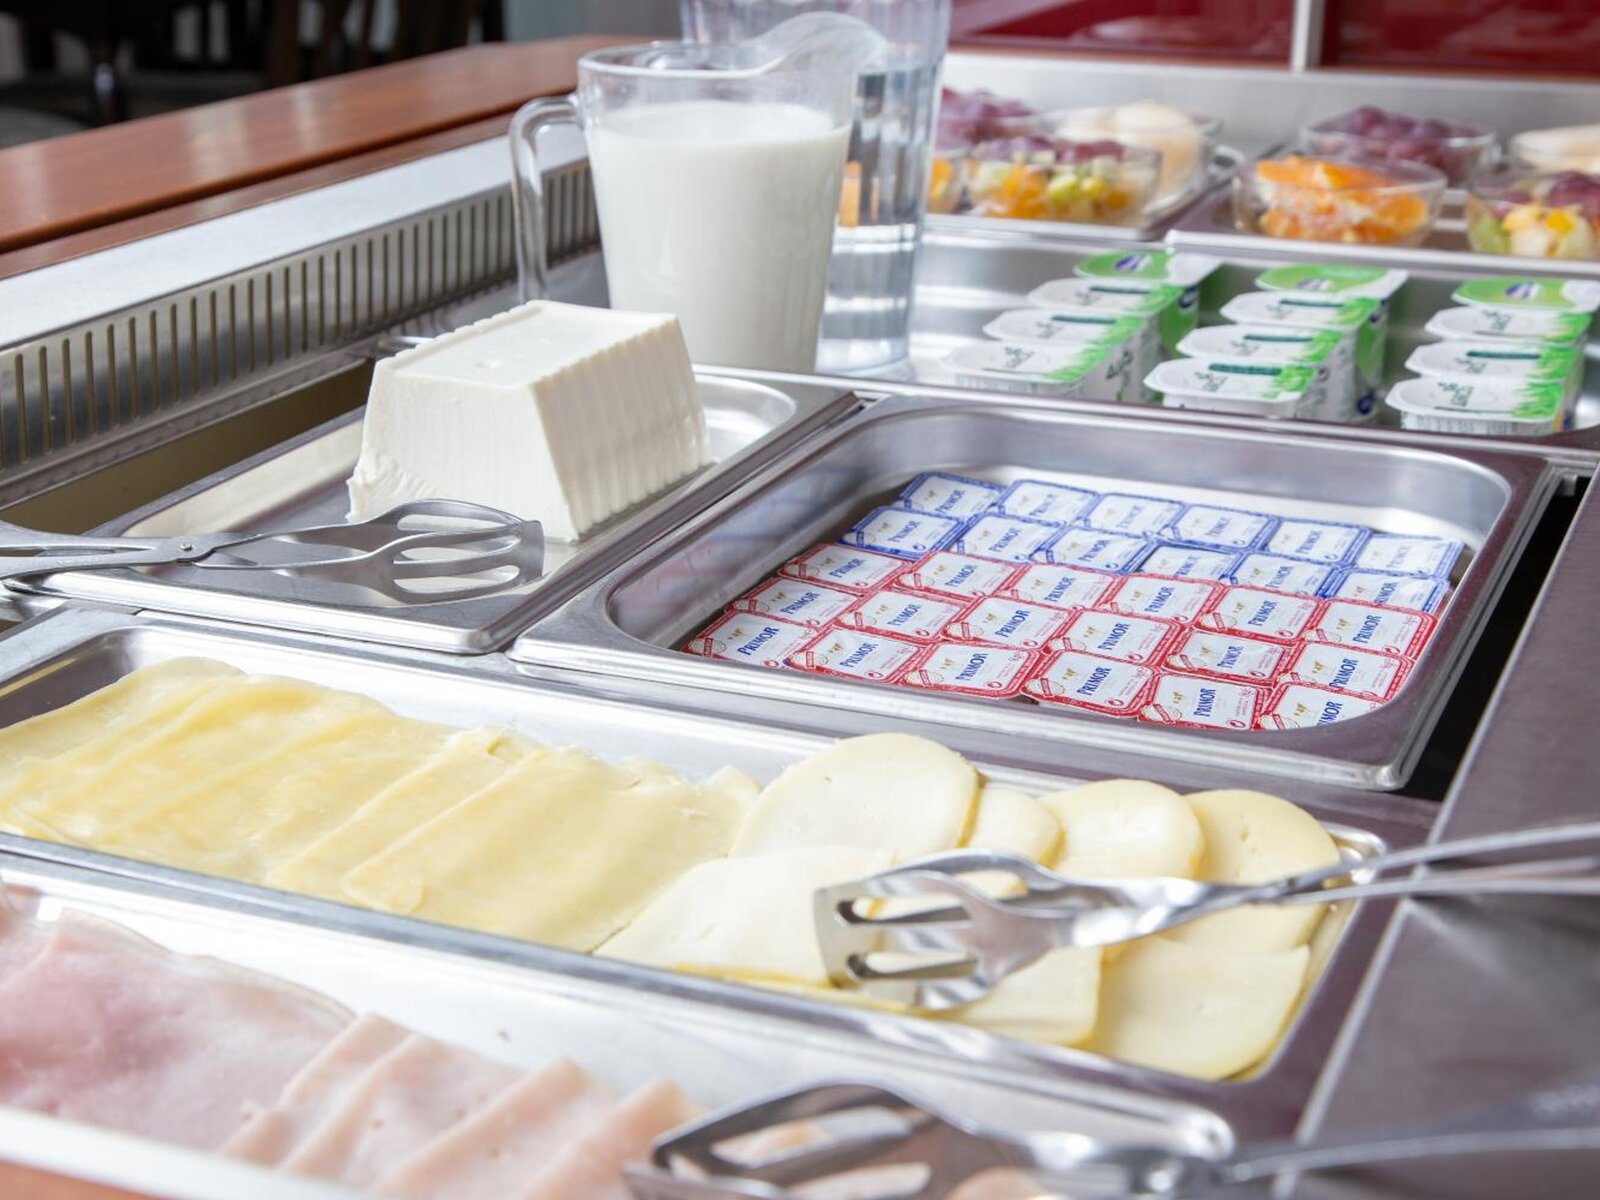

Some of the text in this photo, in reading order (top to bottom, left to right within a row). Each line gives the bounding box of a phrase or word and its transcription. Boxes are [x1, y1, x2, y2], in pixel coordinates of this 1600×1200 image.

[1044, 577, 1075, 601] PRIMOR
[1145, 587, 1174, 612] PRIMOR
[781, 592, 820, 614] PRIMOR
[887, 604, 921, 625] PRIMOR
[1248, 600, 1278, 625] PRIMOR
[995, 610, 1030, 636] PRIMOR
[1098, 623, 1130, 649] PRIMOR
[1353, 615, 1382, 643] PRIMOR
[737, 627, 779, 655] PRIMOR
[839, 643, 878, 667] PRIMOR
[956, 654, 988, 680] PRIMOR
[1077, 667, 1111, 695] PRIMOR
[1329, 658, 1358, 687] PRIMOR
[1194, 688, 1216, 716] PRIMOR
[1318, 702, 1343, 724] IMOR
